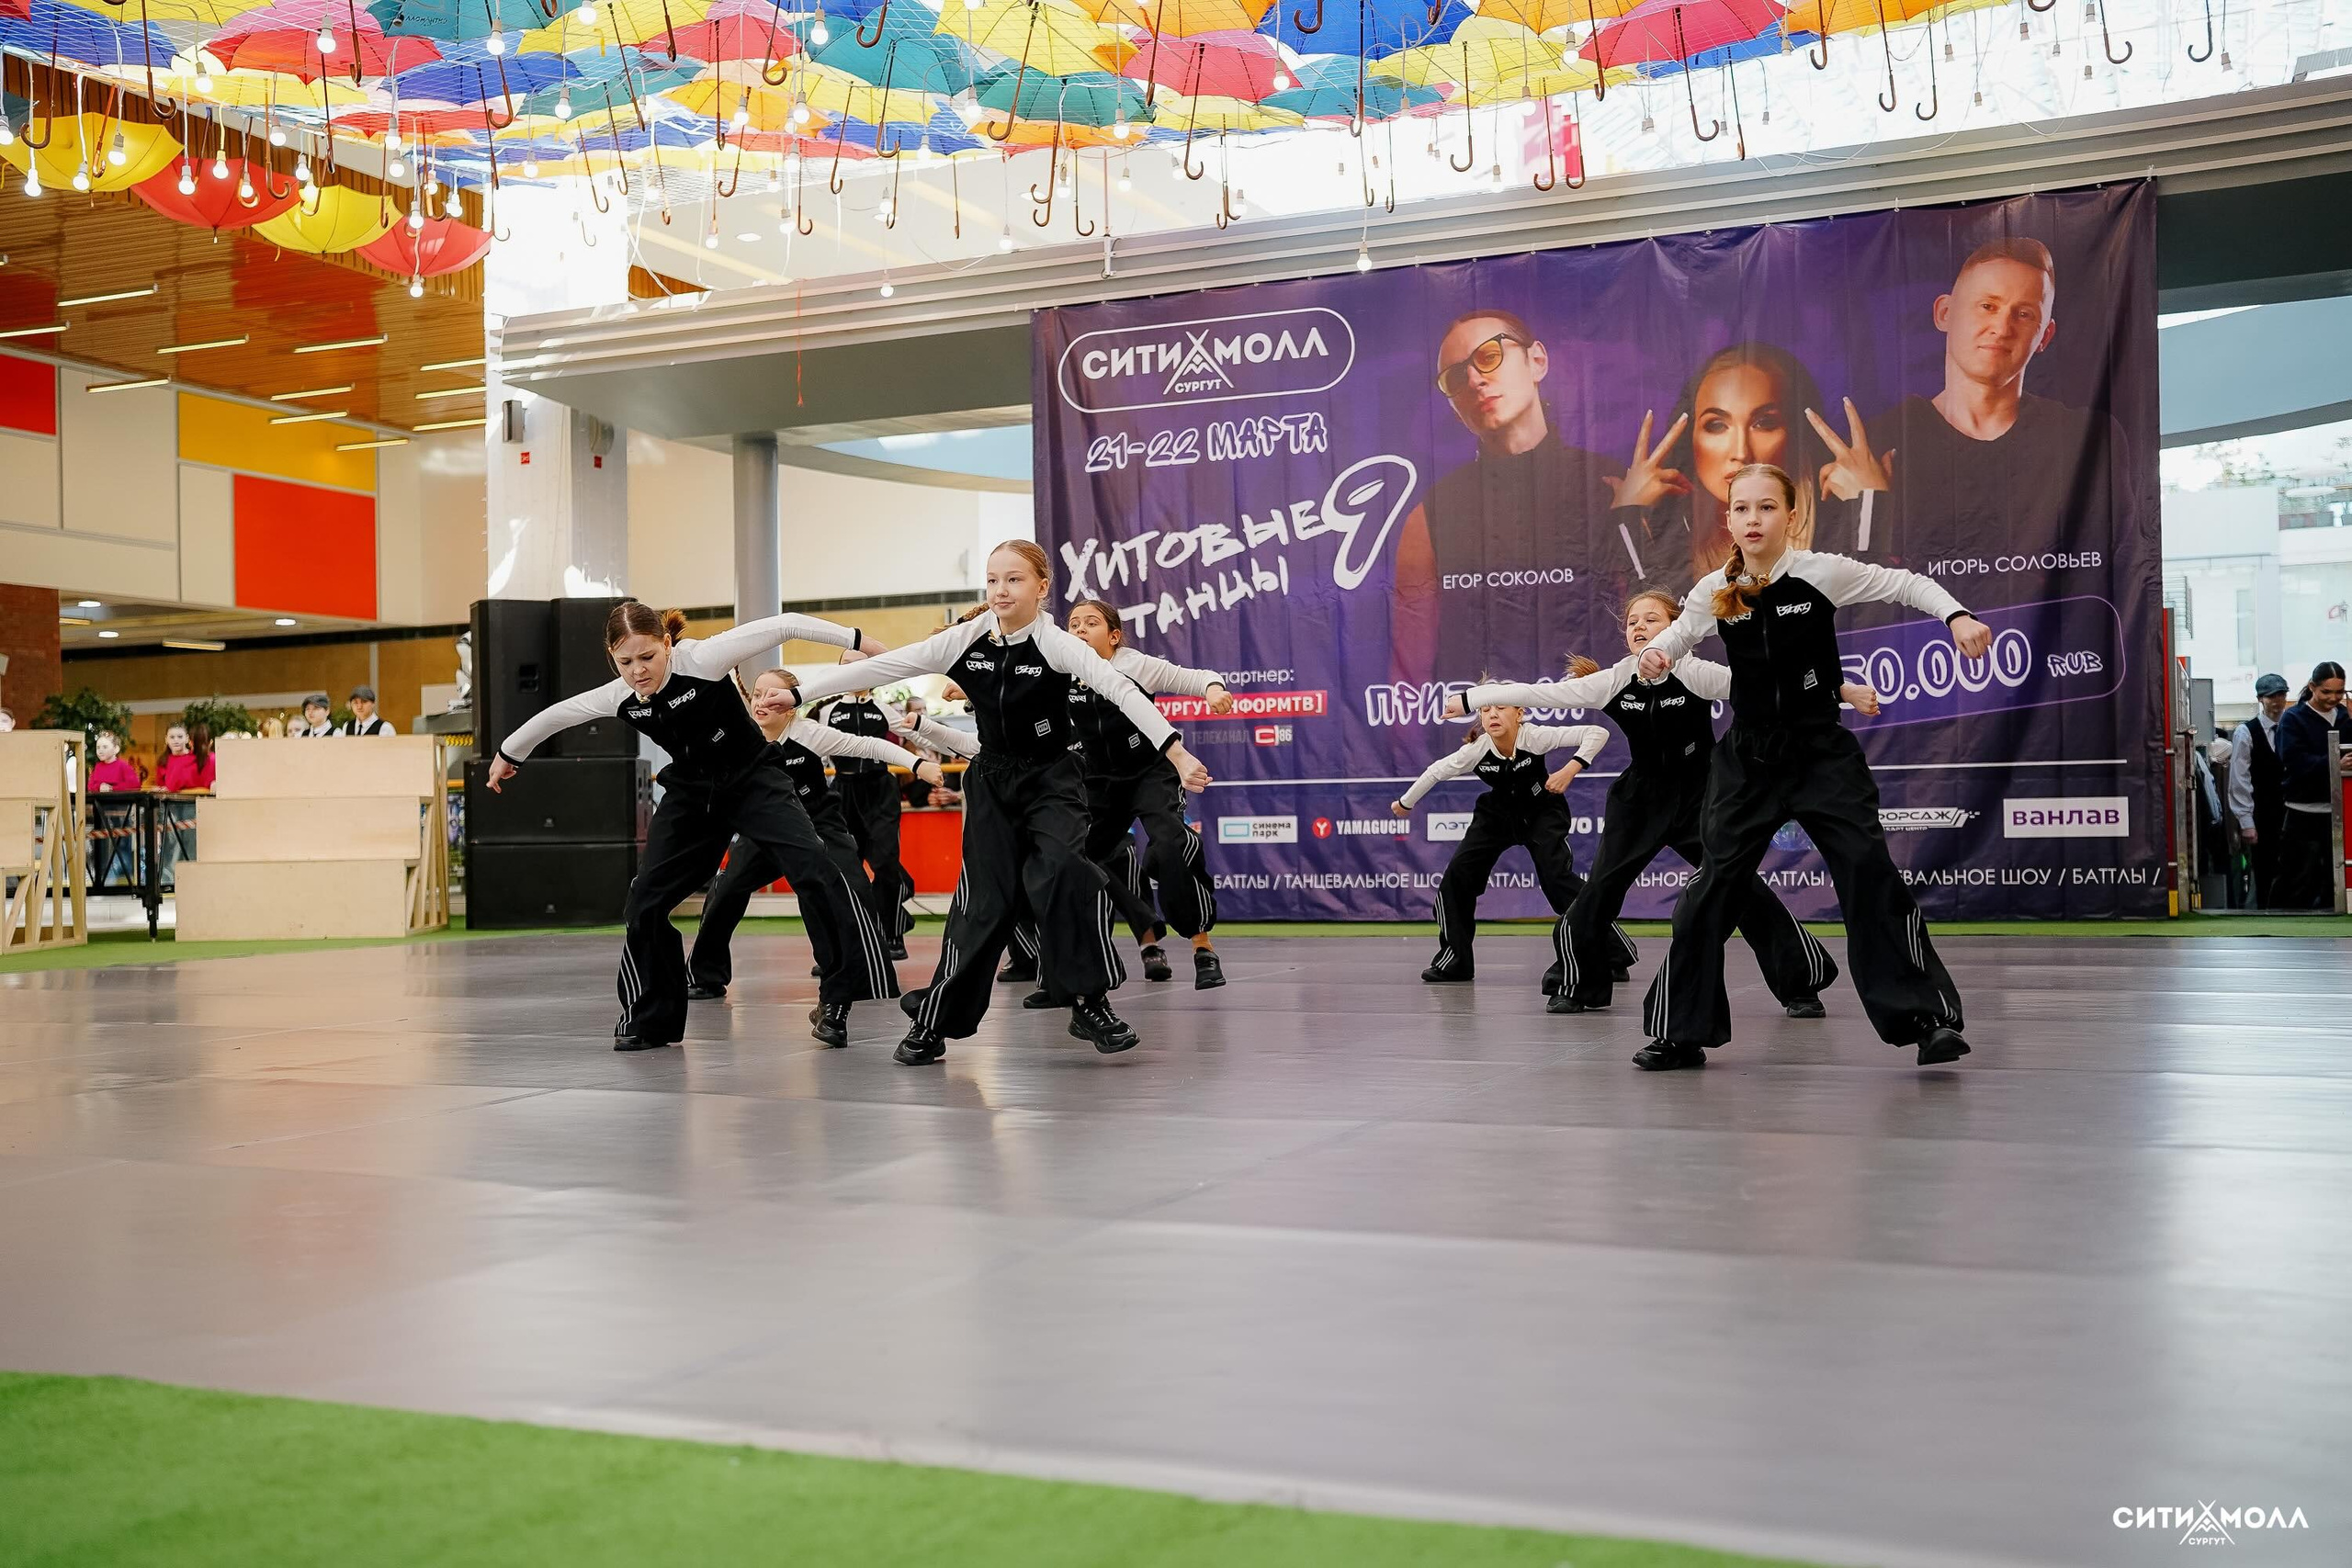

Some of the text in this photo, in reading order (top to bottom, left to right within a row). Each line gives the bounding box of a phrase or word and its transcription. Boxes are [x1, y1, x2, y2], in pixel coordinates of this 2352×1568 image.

[1174, 378, 1222, 393] СУРГУТ
[1085, 412, 1328, 472] 21-22 МАРТА
[1060, 499, 1329, 603] ХИТОВЫЕ
[1928, 551, 2102, 576] ИГОРЬ СОЛОВЬЕВ
[1442, 568, 1574, 590] ЕГОР СОКОЛОВ
[1118, 556, 1289, 638] ТАНЦЫ
[2047, 651, 2103, 678] RUB
[1192, 727, 1250, 745] ТЕЛЕКАНАЛ
[1252, 822, 1291, 830] синема
[1336, 819, 1410, 835] YAMAGUCHI
[1435, 821, 1469, 831] ЛЭТ
[2012, 808, 2120, 827] ванлав
[1252, 829, 1278, 838] парк
[1214, 874, 1269, 890] БАТТЛЫ
[1284, 873, 1409, 890] ТАНЦЕВАЛЬНОЕ
[1414, 873, 1443, 888] ШО
[1487, 873, 1535, 888] АТТЛЫ
[2001, 867, 2052, 886] ШОУ
[2073, 867, 2146, 886] БАТТЛЫ
